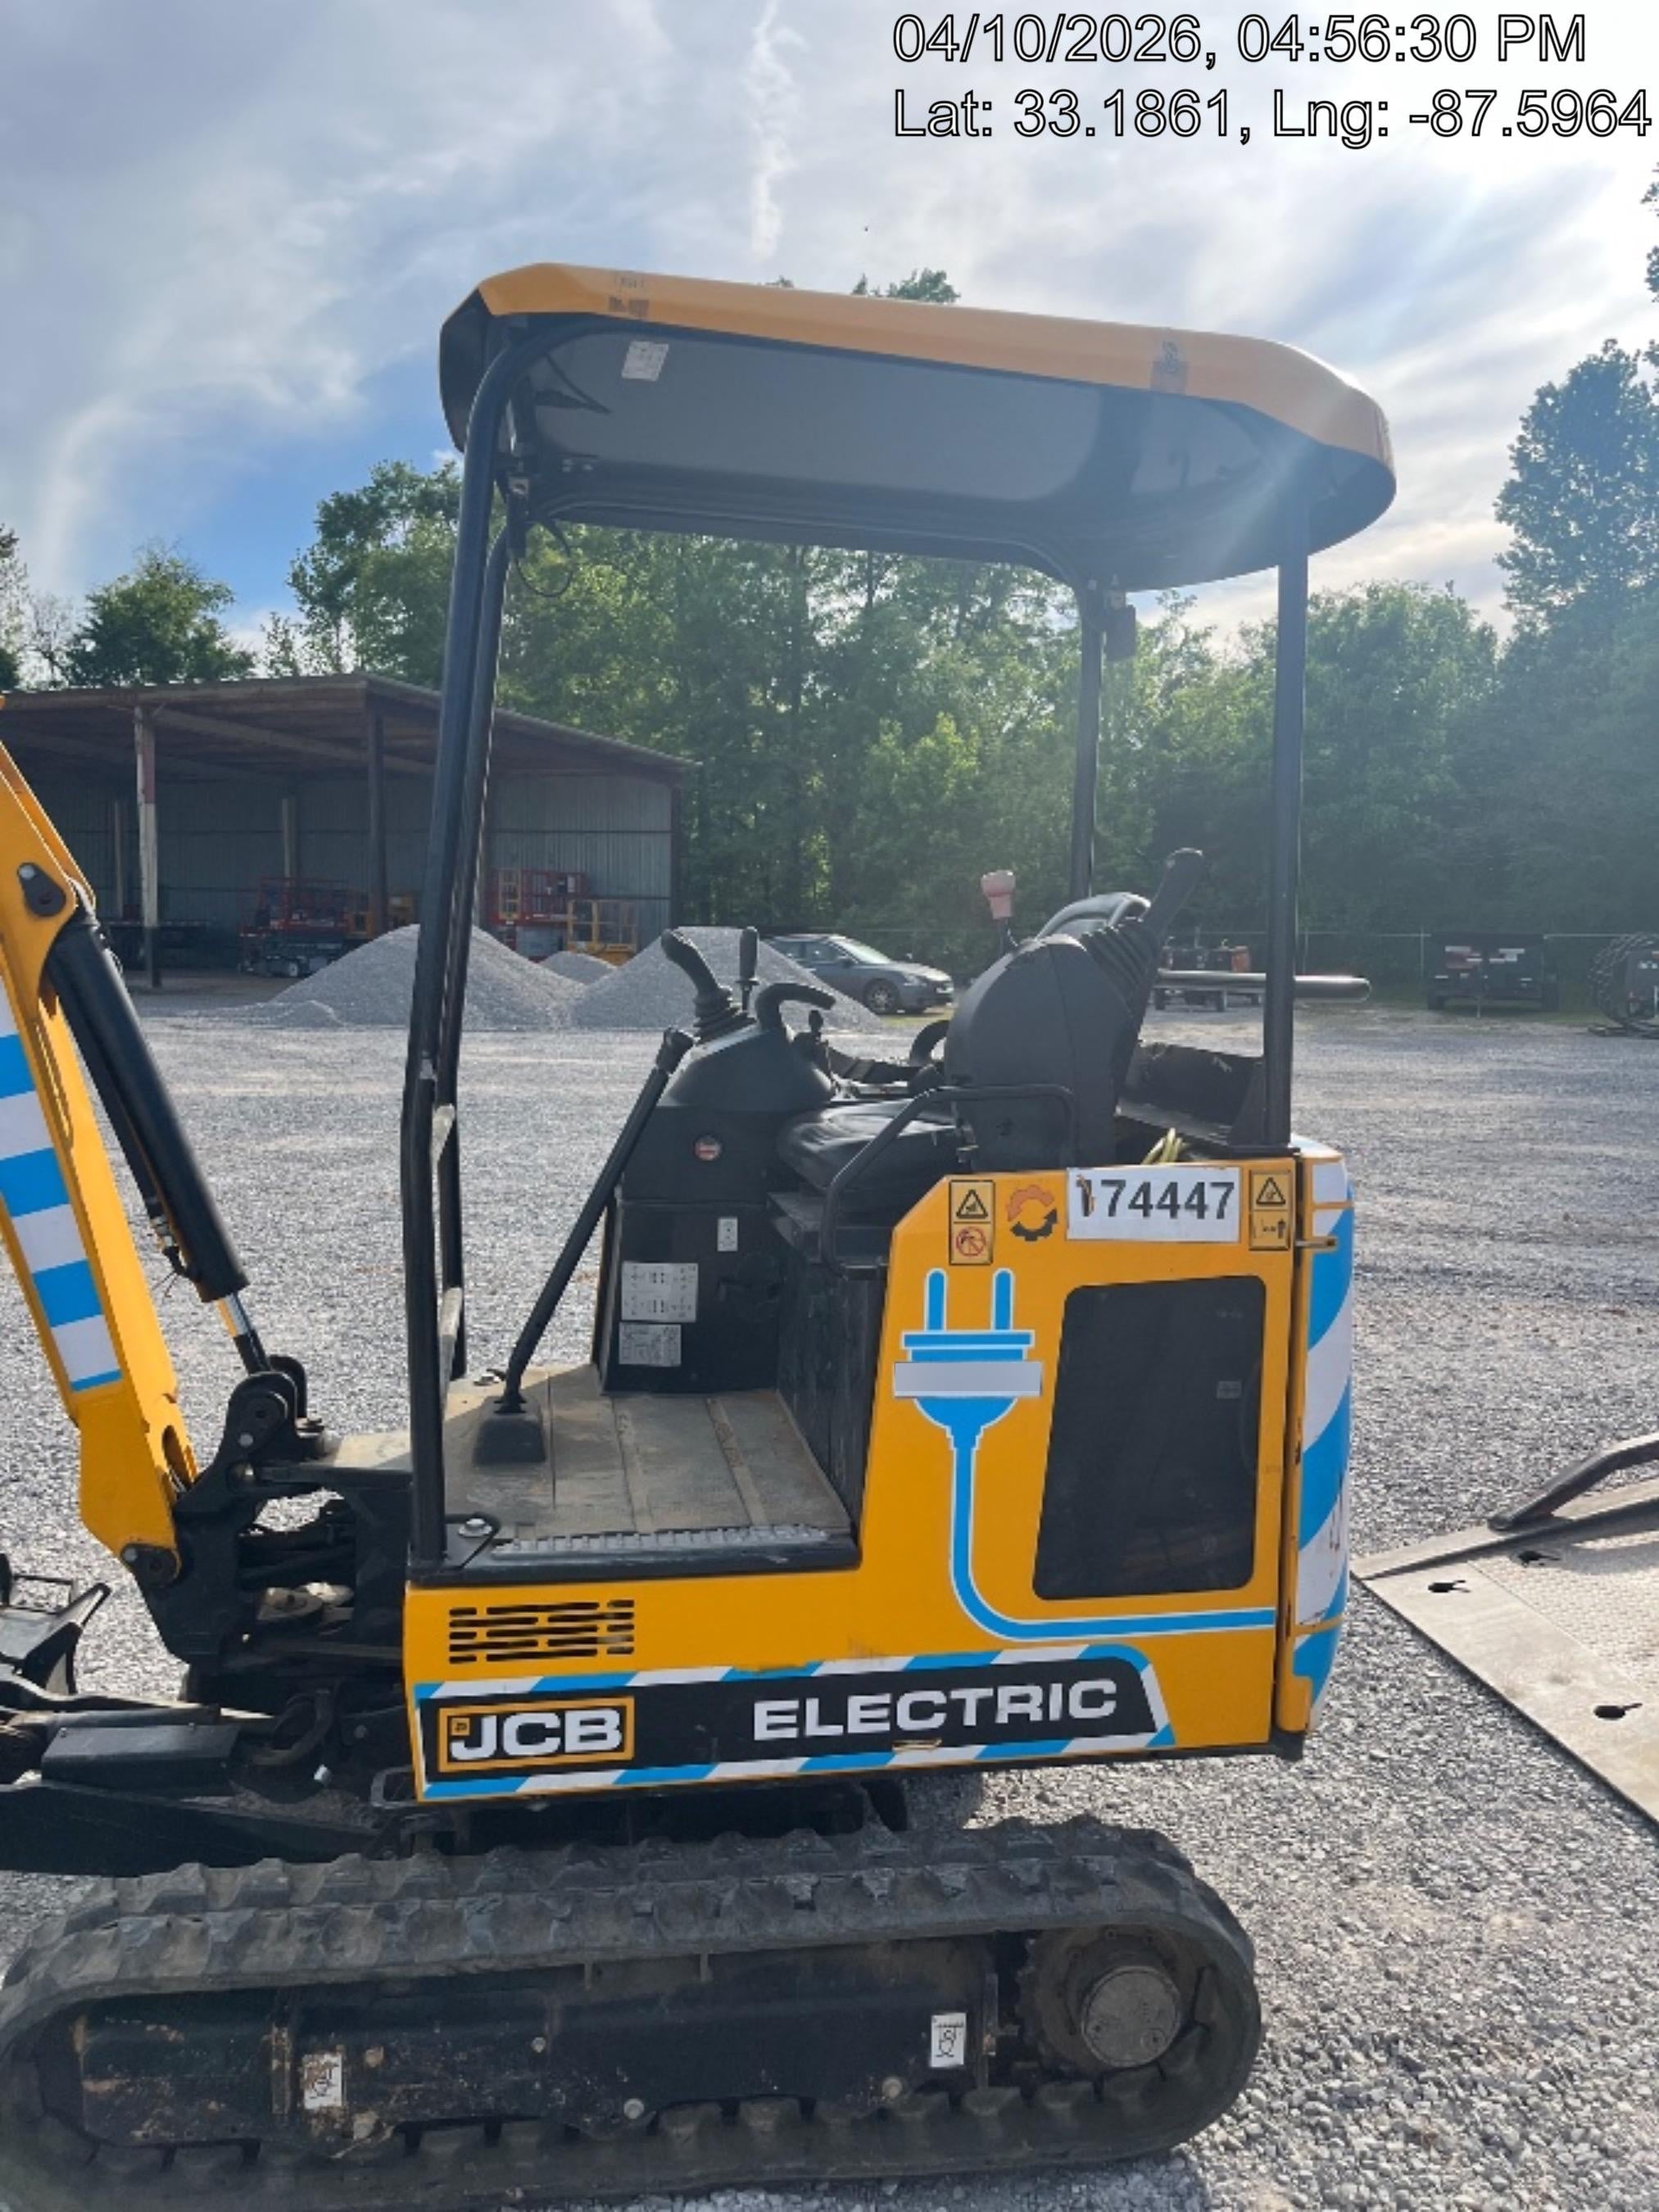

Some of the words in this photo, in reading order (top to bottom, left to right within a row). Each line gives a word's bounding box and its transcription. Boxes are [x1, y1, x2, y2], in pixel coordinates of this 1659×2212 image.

[1076, 1178, 1235, 1220] 174447
[451, 1709, 623, 1761] JCB
[753, 1678, 1118, 1742] ELECTRIC
